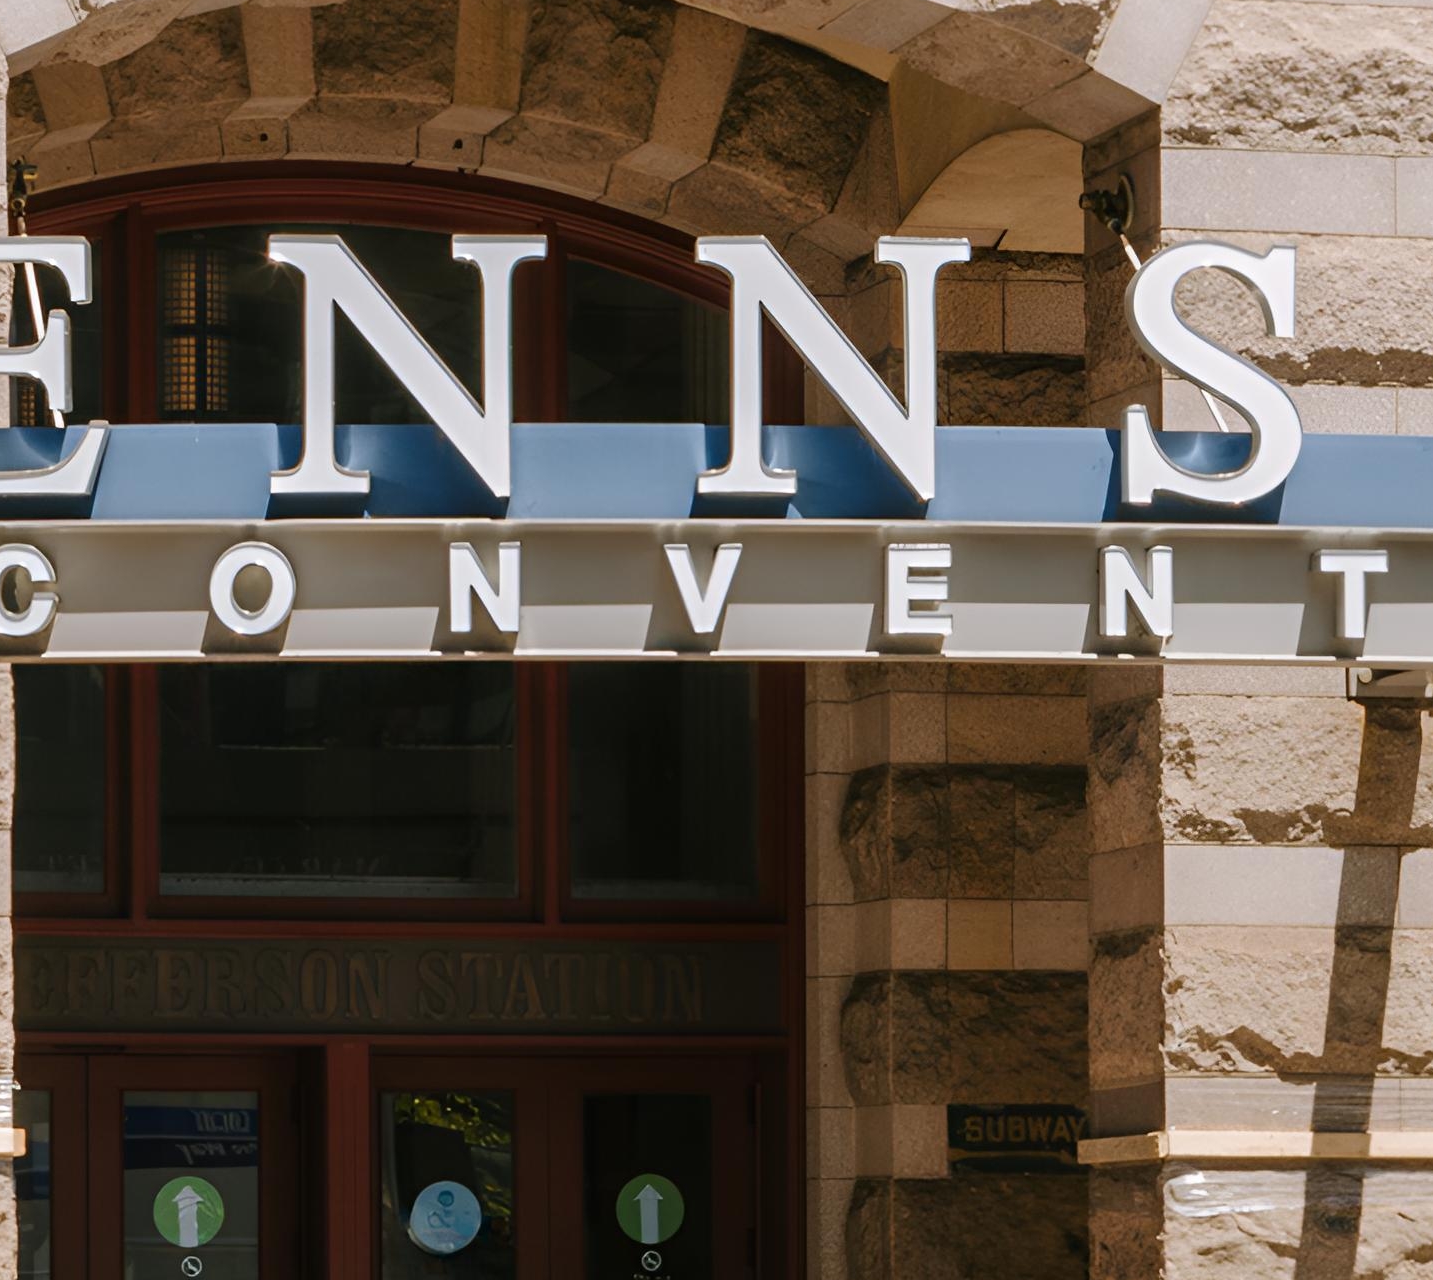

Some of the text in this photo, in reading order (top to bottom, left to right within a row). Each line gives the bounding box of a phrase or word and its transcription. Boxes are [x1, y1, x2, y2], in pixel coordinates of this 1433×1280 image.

[16, 948, 709, 1023] EFFERSON STATION
[964, 1114, 1085, 1143] SUBWAY
